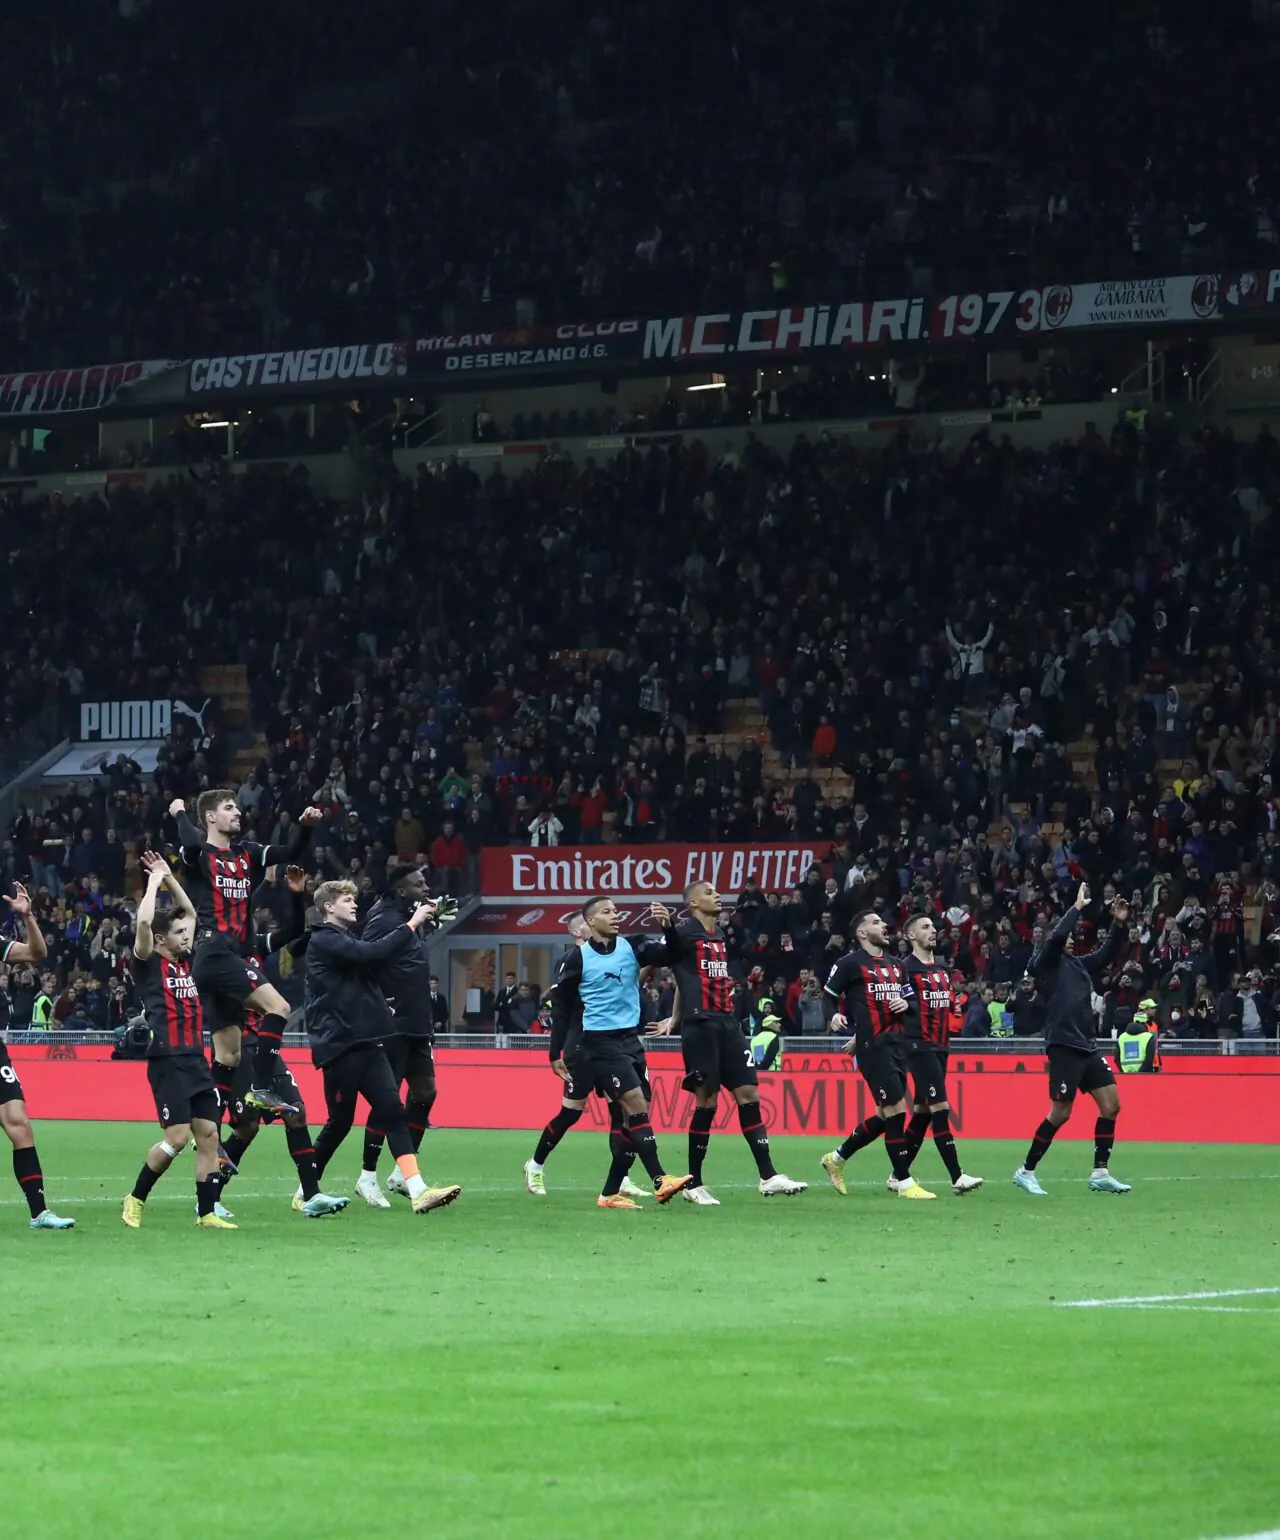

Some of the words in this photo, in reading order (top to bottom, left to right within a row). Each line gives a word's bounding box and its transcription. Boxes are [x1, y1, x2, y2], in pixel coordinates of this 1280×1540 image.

[939, 290, 1040, 337] 1973
[1095, 288, 1165, 306] GAMBARA
[445, 347, 575, 370] DESENZANO
[81, 700, 171, 740] PUMA
[511, 851, 671, 891] Emirates
[685, 852, 723, 890] FLY
[729, 850, 814, 889] BETTER
